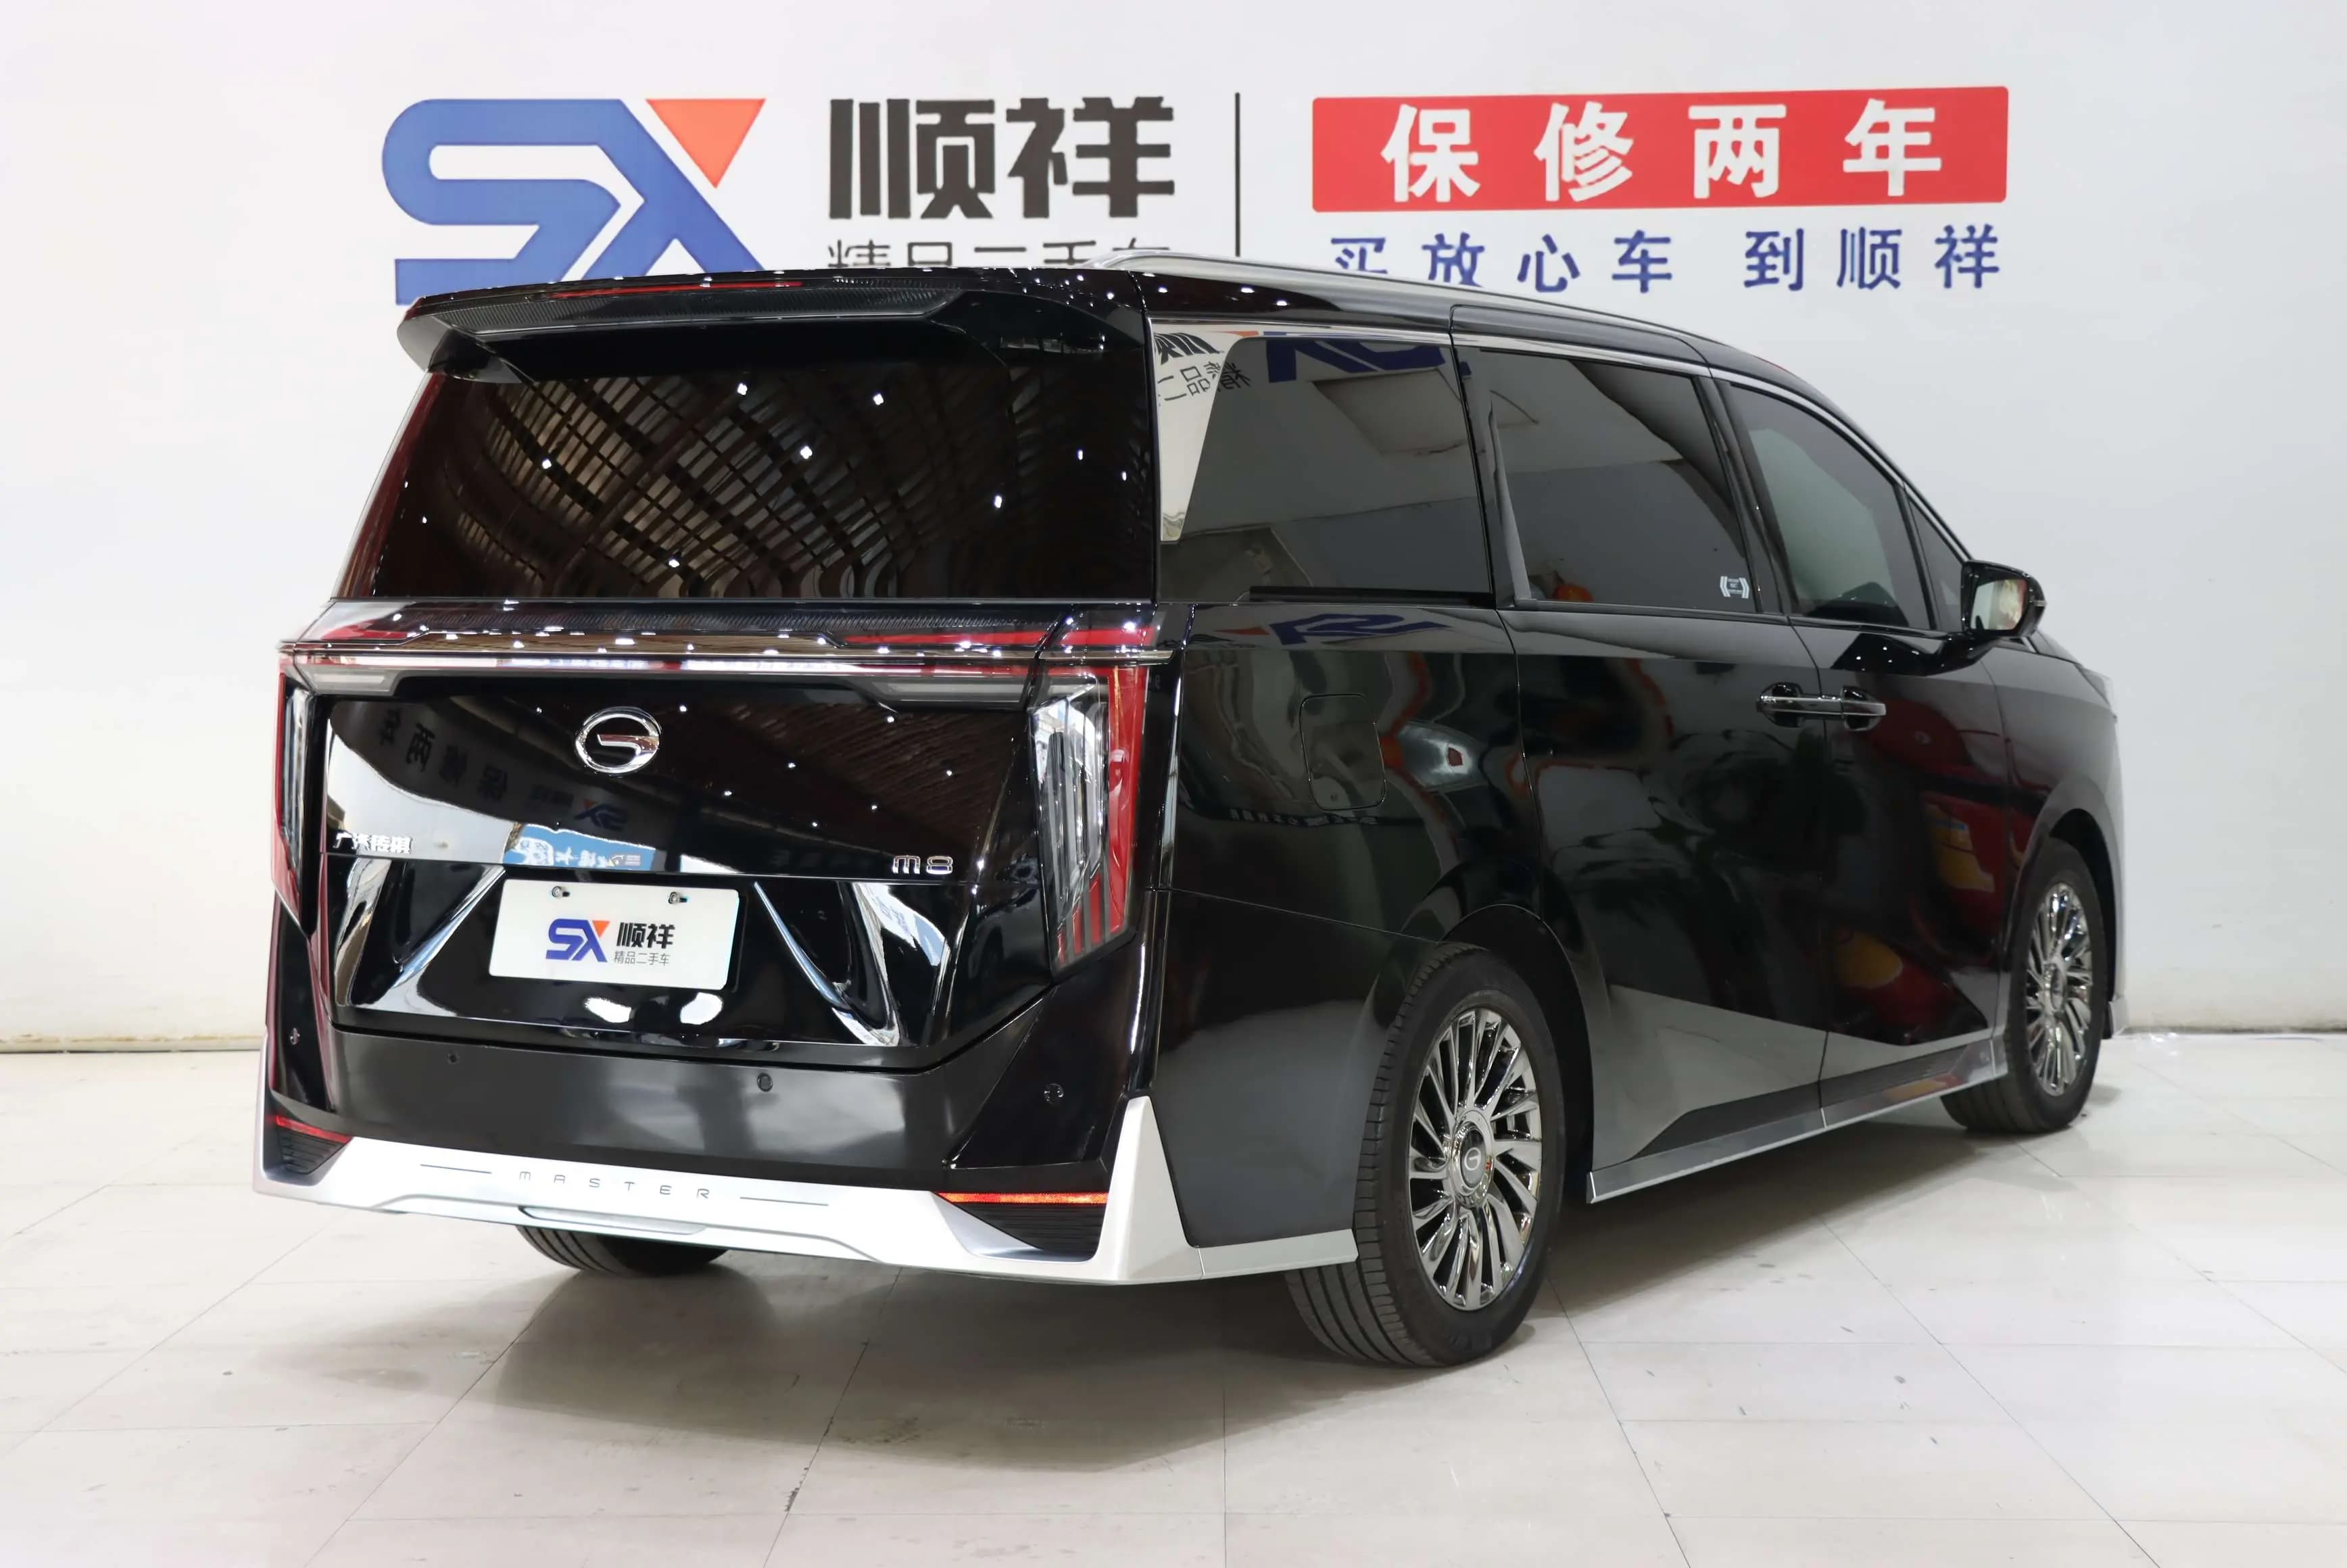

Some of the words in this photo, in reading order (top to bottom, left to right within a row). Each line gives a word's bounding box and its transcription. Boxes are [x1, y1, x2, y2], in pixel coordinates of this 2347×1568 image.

[829, 97, 1175, 219] 顺祥
[1381, 99, 1942, 201] 保修两年
[1744, 224, 2000, 291] 到顺祥
[613, 950, 671, 966] 精品二手车
[616, 922, 675, 949] 顺祥
[518, 1171, 710, 1200] MASTER
